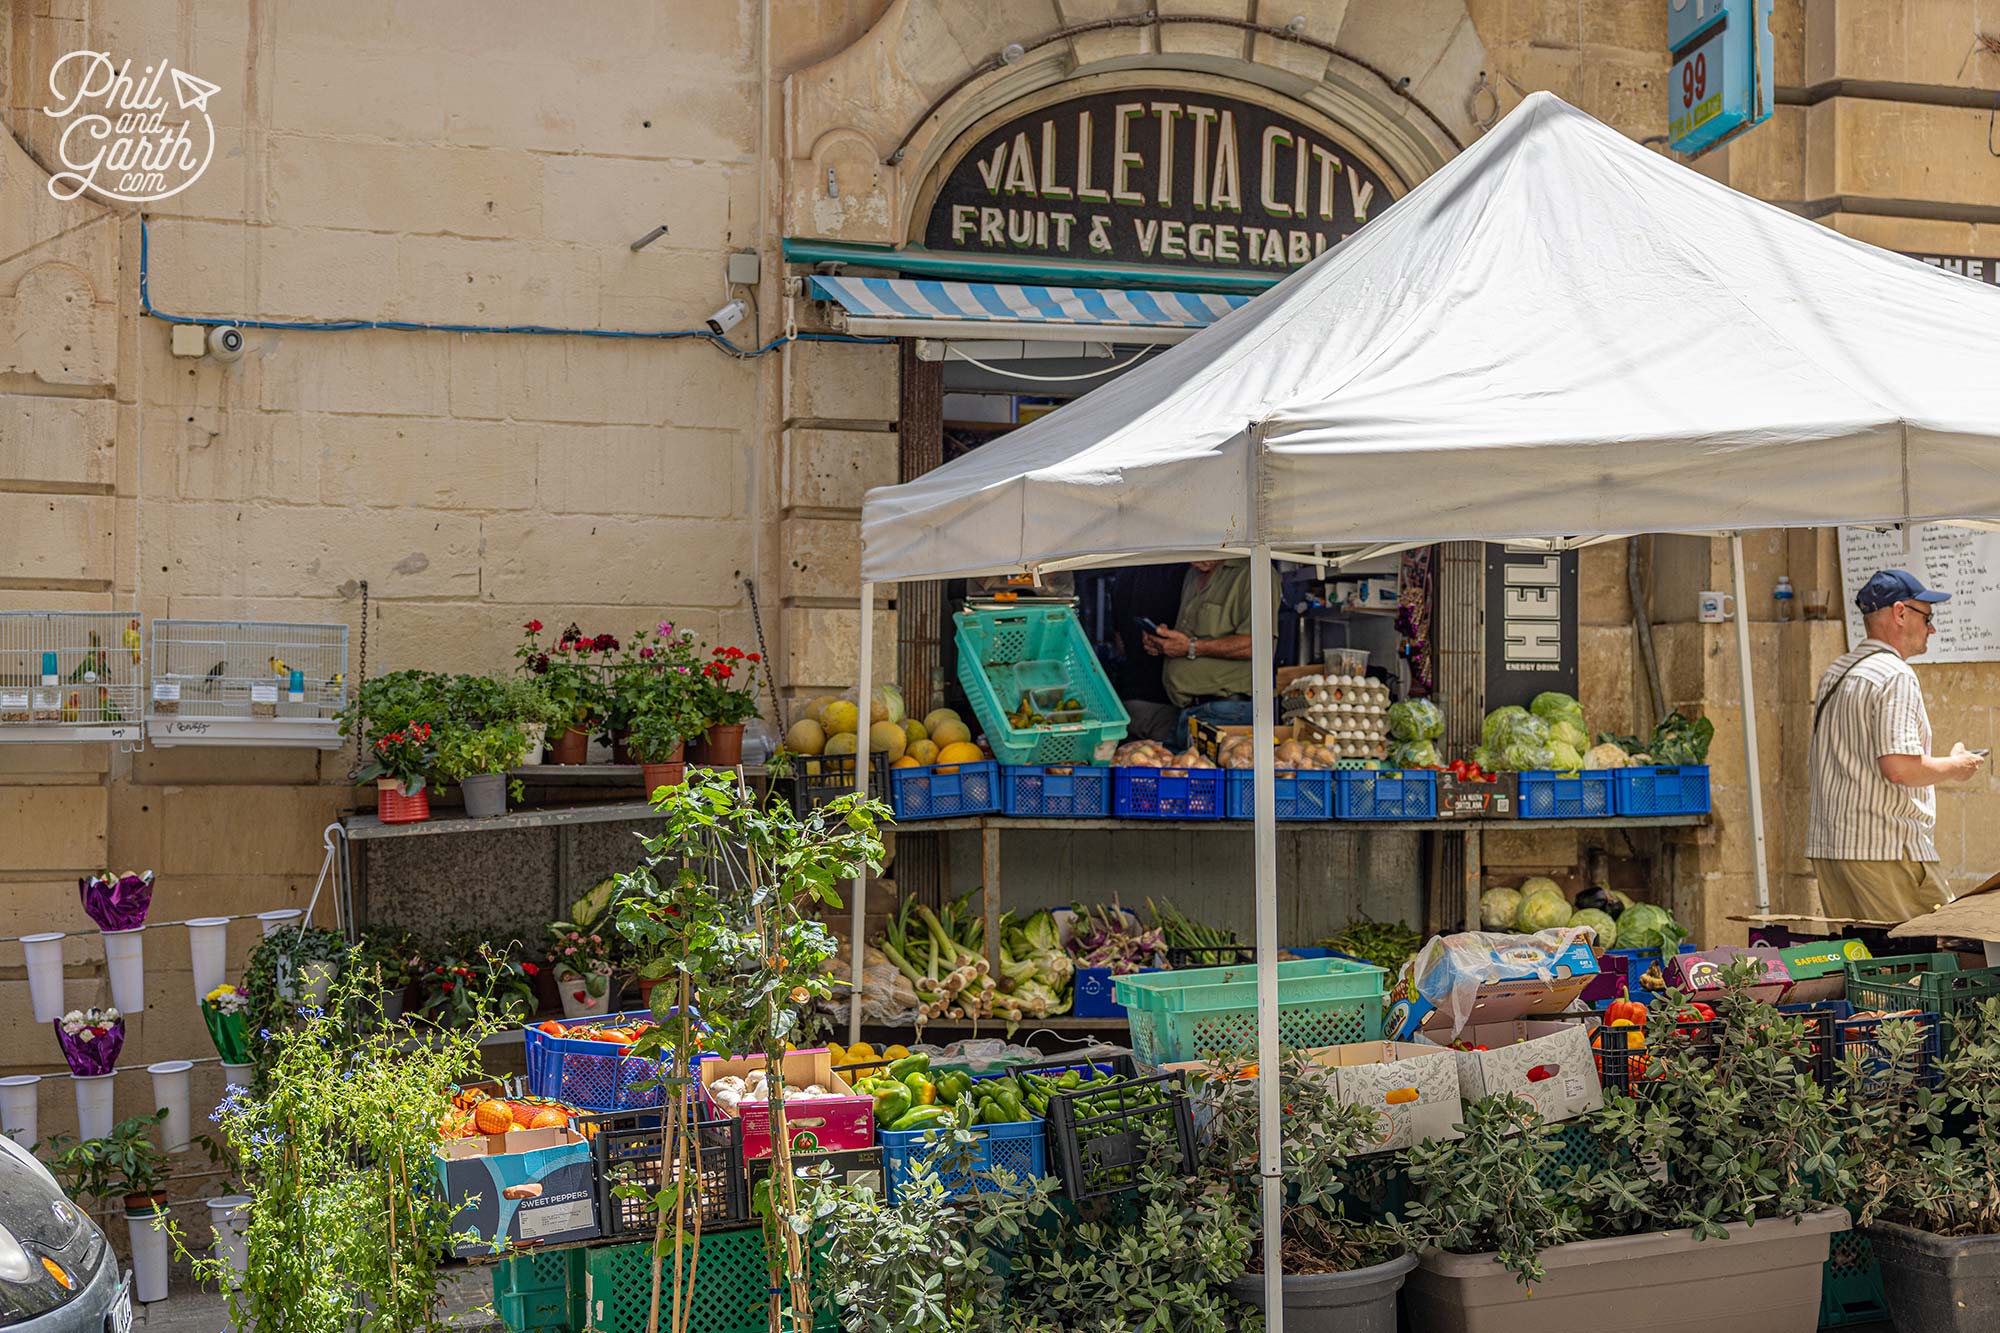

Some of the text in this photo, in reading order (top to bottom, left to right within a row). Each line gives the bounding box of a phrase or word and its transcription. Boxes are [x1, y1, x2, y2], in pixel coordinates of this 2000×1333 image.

[1683, 52, 1706, 109] 99
[977, 102, 1374, 223] VALLETTA CITY
[952, 204, 1350, 267] FRUIT & VEGETABL
[1504, 543, 1560, 661] HEL
[1505, 663, 1560, 671] ENERGY DRINK
[1794, 953, 1841, 966] SAFRESCO
[1695, 975, 1711, 986] EAT
[521, 1190, 588, 1209] SWEET PEPPERS
